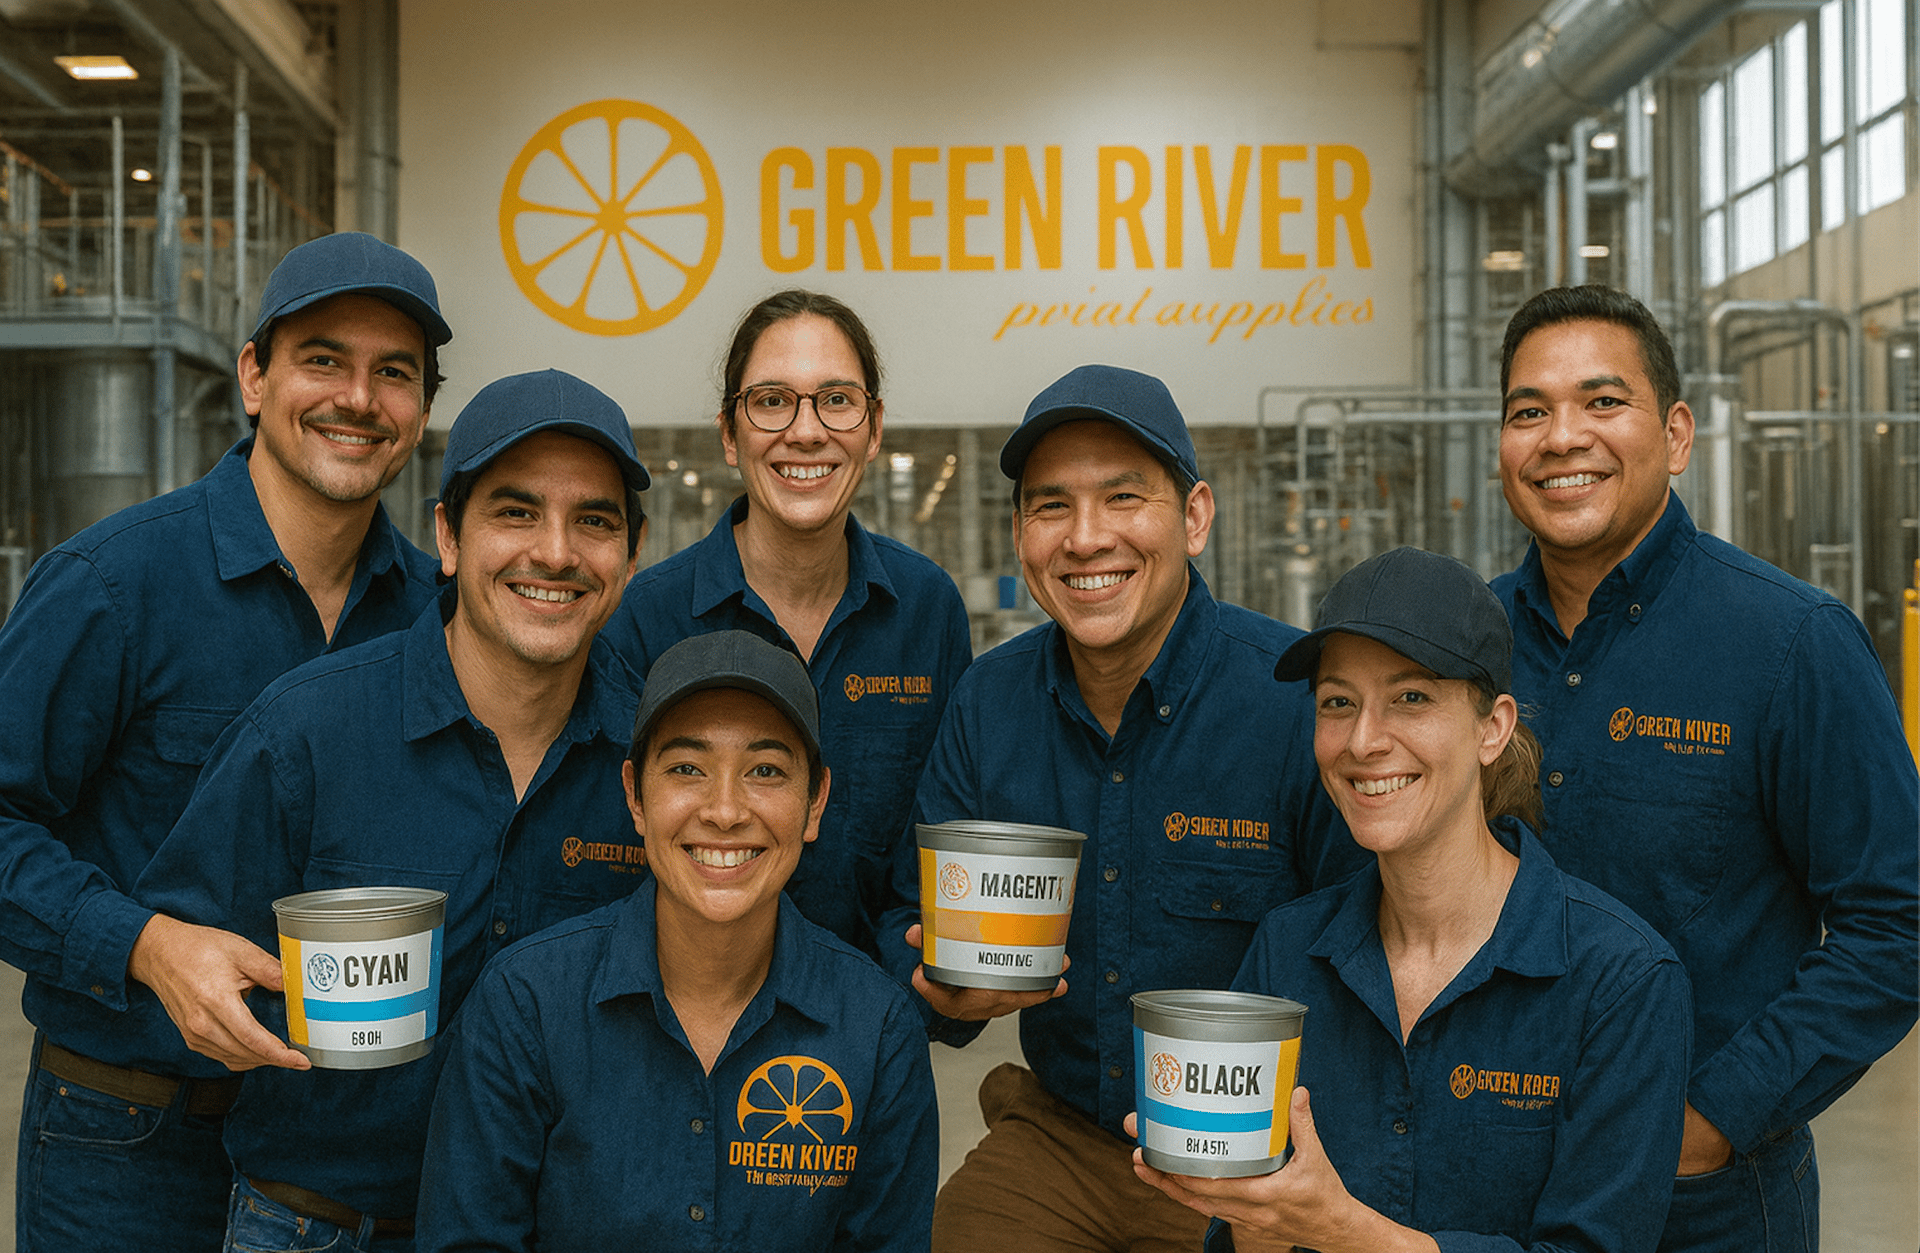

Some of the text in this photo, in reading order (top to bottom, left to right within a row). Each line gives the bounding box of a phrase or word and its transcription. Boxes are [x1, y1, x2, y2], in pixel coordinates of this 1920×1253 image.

[760, 144, 1375, 273] GREEN RIVER
[343, 952, 409, 988] CYAN
[1185, 1062, 1263, 1097] BLACK
[799, 1143, 858, 1172] KIVER
